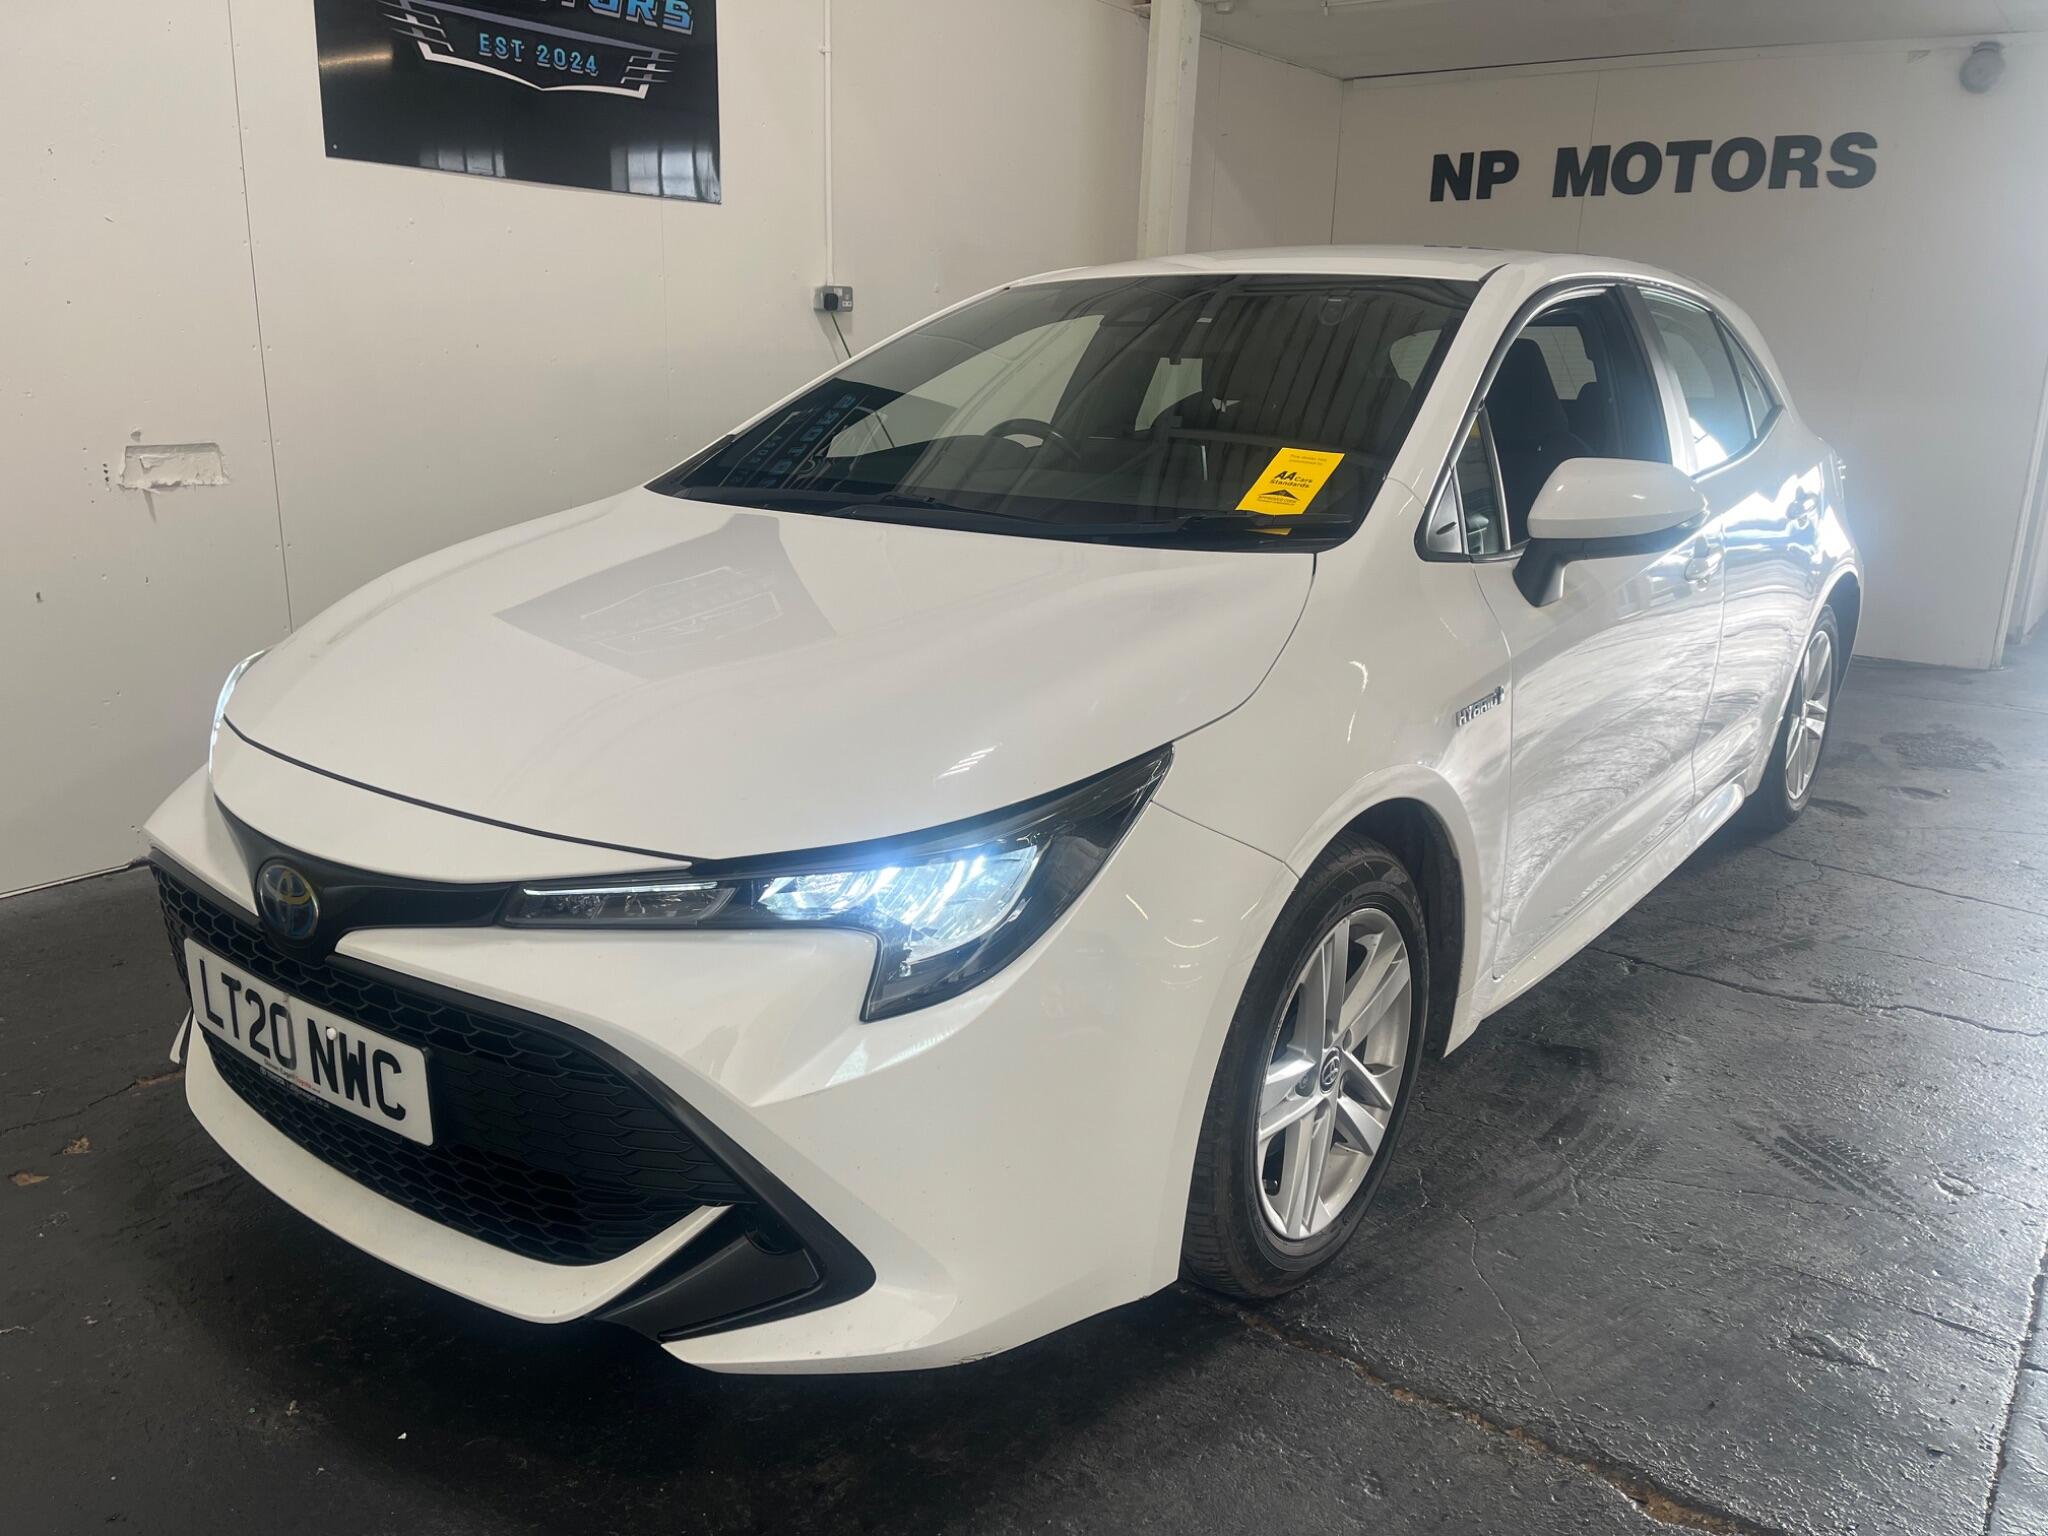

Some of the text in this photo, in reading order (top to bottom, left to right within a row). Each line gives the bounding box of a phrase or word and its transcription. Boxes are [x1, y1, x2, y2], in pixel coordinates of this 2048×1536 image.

[479, 33, 599, 76] EST 2024
[1430, 131, 1877, 202] NP MOTORS
[1274, 470, 1297, 480] AA
[200, 959, 297, 1070] LT20
[307, 1018, 406, 1121] NWC
